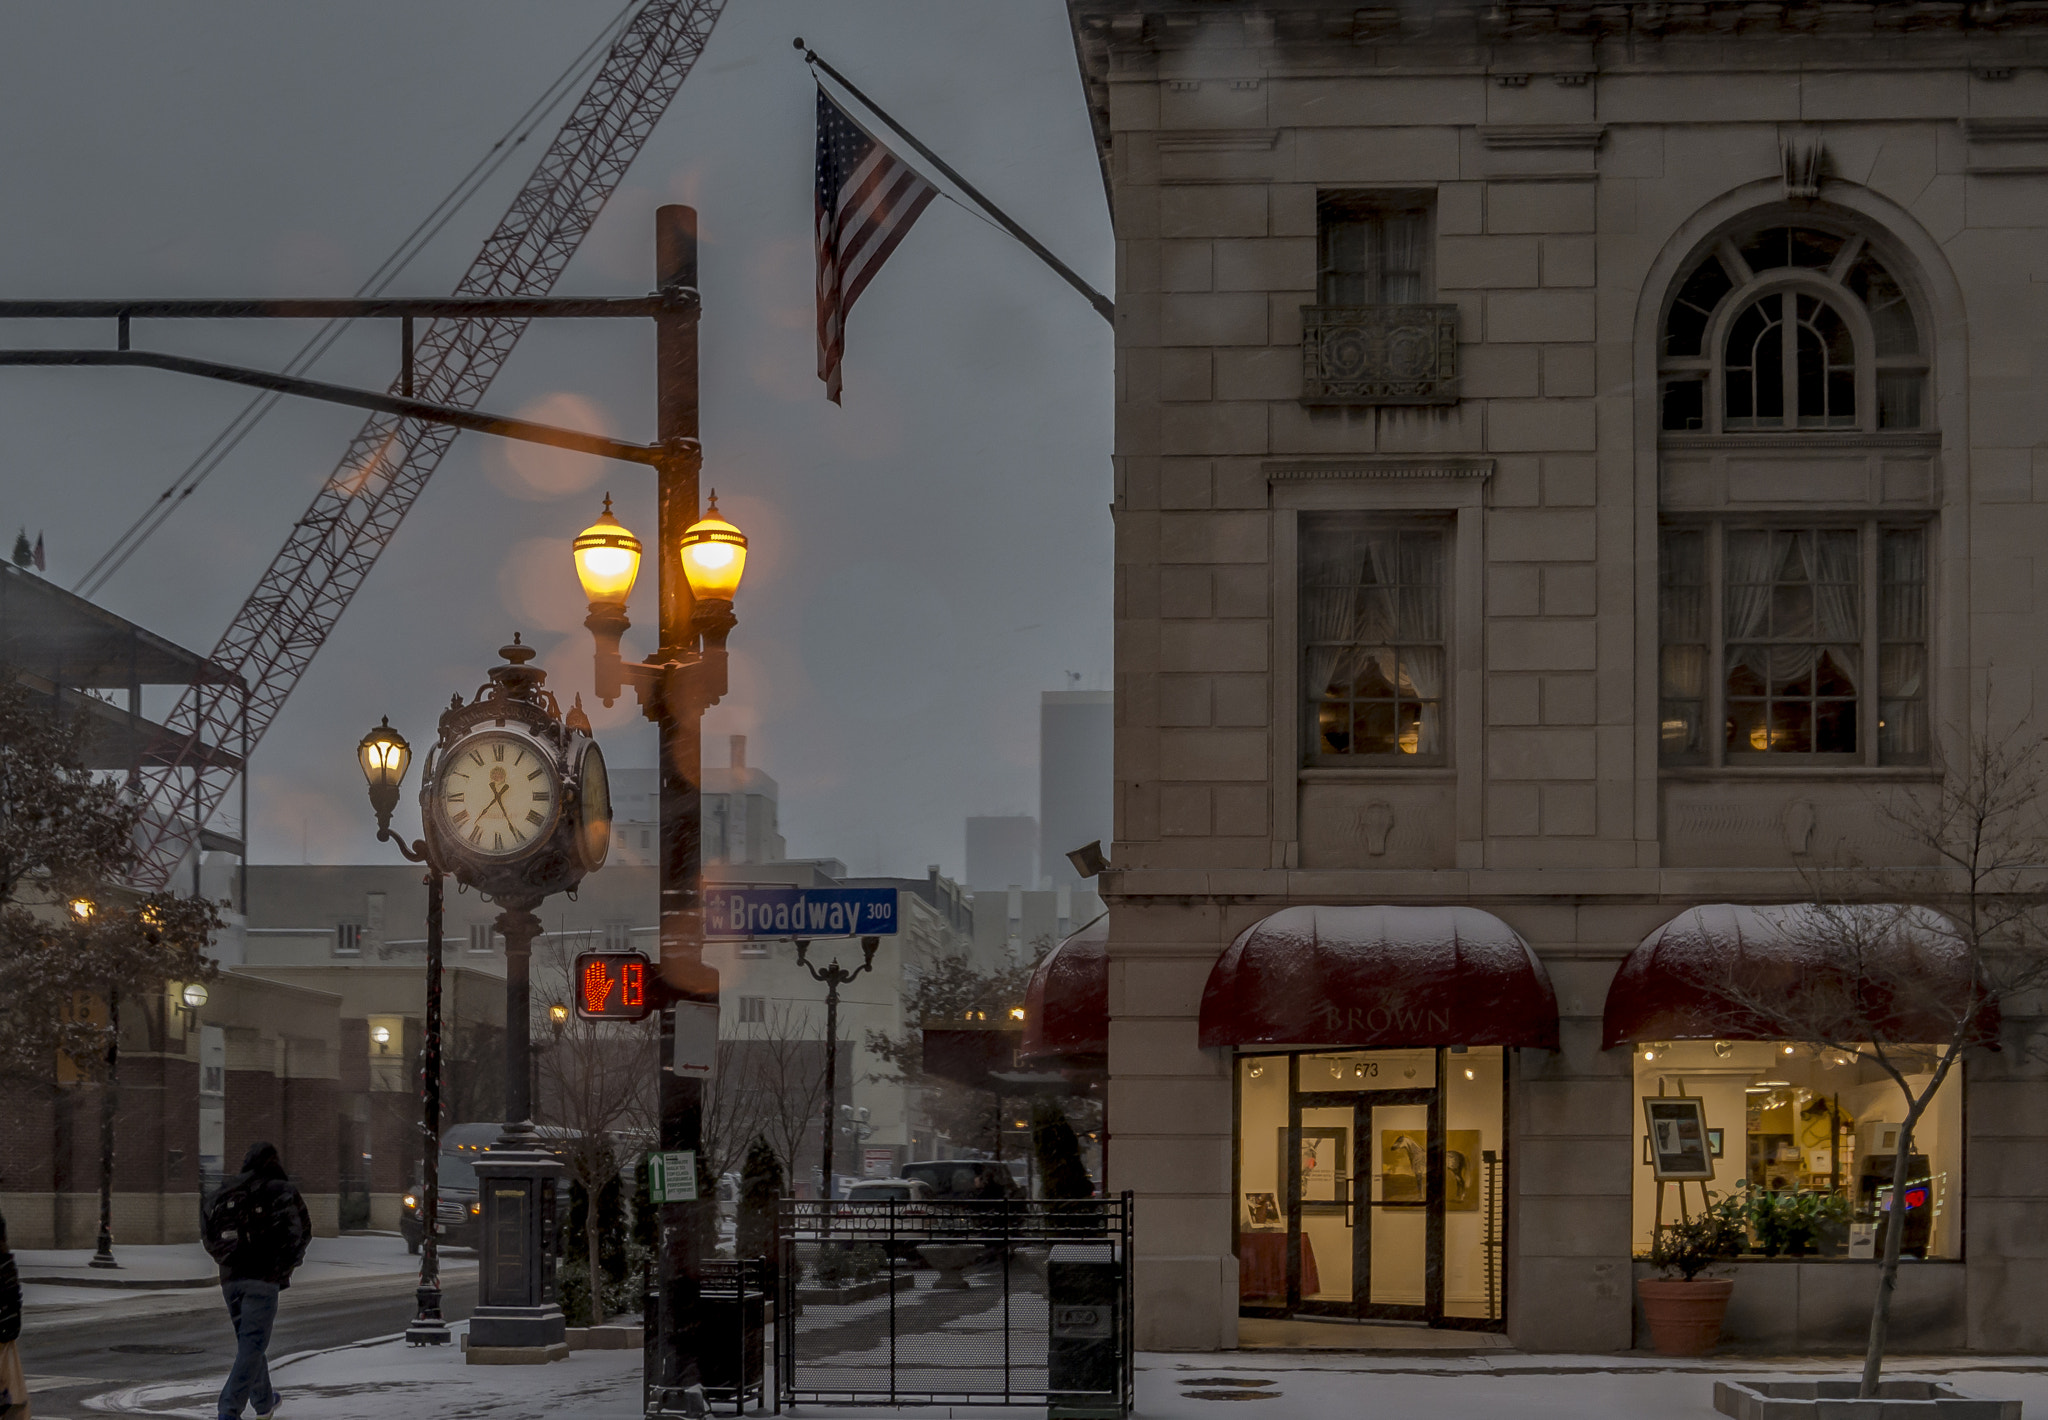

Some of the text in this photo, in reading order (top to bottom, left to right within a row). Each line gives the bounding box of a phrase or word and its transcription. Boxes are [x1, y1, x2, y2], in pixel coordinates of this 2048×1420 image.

[712, 895, 891, 936] W Broadway 300
[622, 964, 643, 1006] 13
[1327, 1006, 1450, 1032] BROWN
[1354, 1063, 1378, 1078] 673
